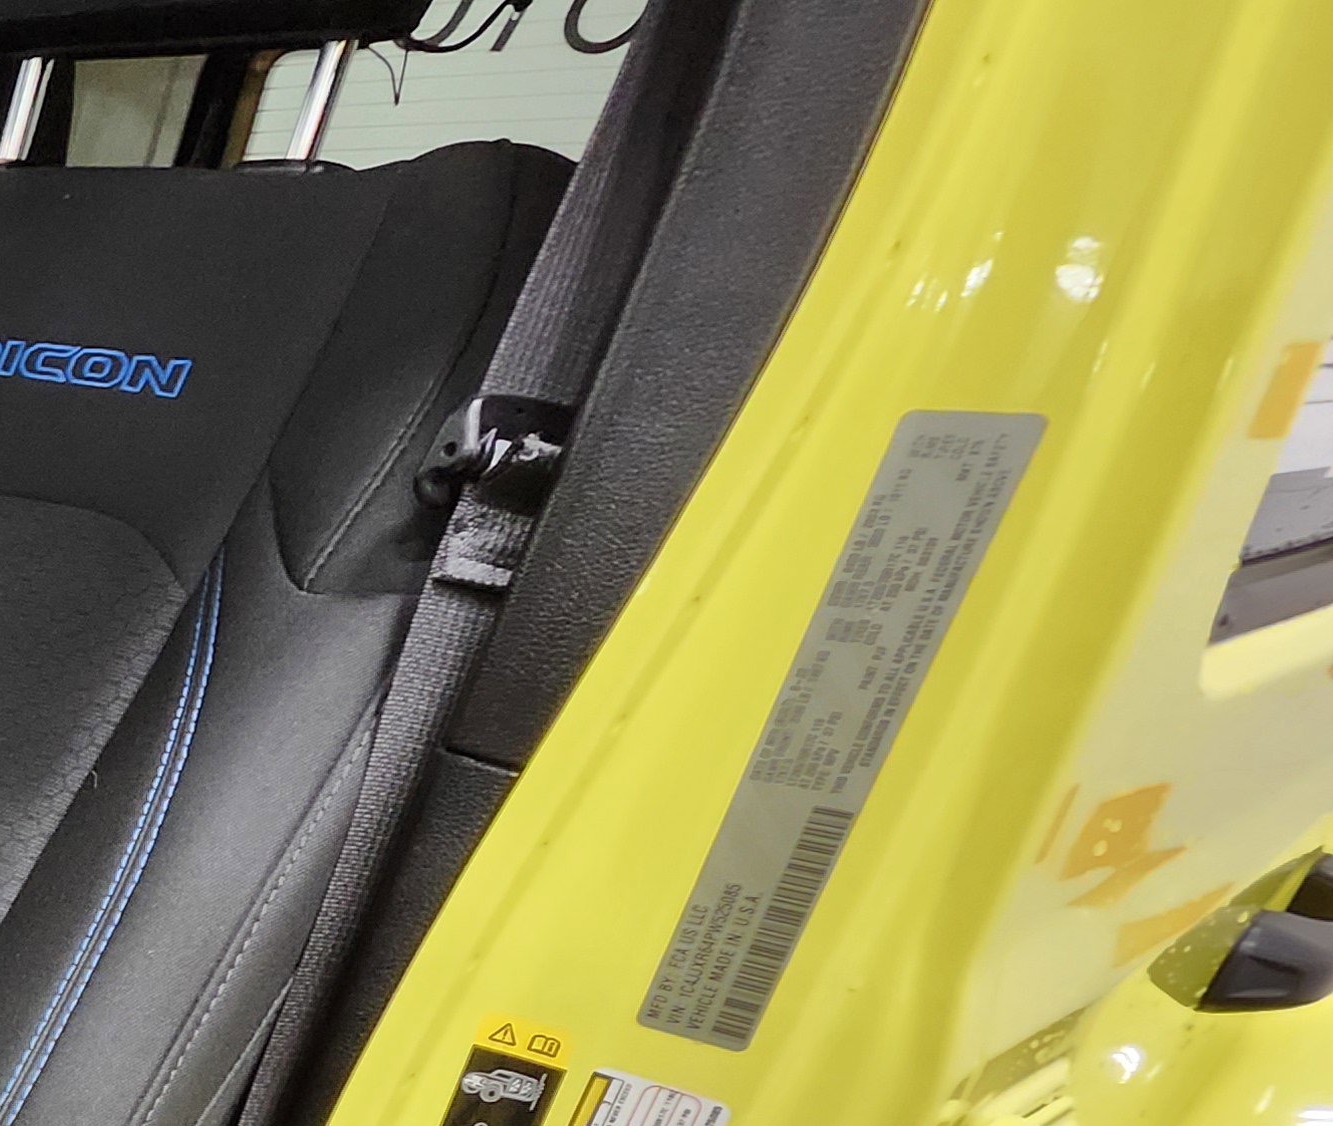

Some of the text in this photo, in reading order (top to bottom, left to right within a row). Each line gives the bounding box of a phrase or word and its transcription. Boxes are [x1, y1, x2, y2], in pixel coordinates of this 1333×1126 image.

[686, 902, 710, 926] LLC
[677, 926, 699, 945] US
[667, 946, 690, 969] FCA
[685, 985, 719, 1031] VEHICLE
[707, 948, 736, 983] MADE
